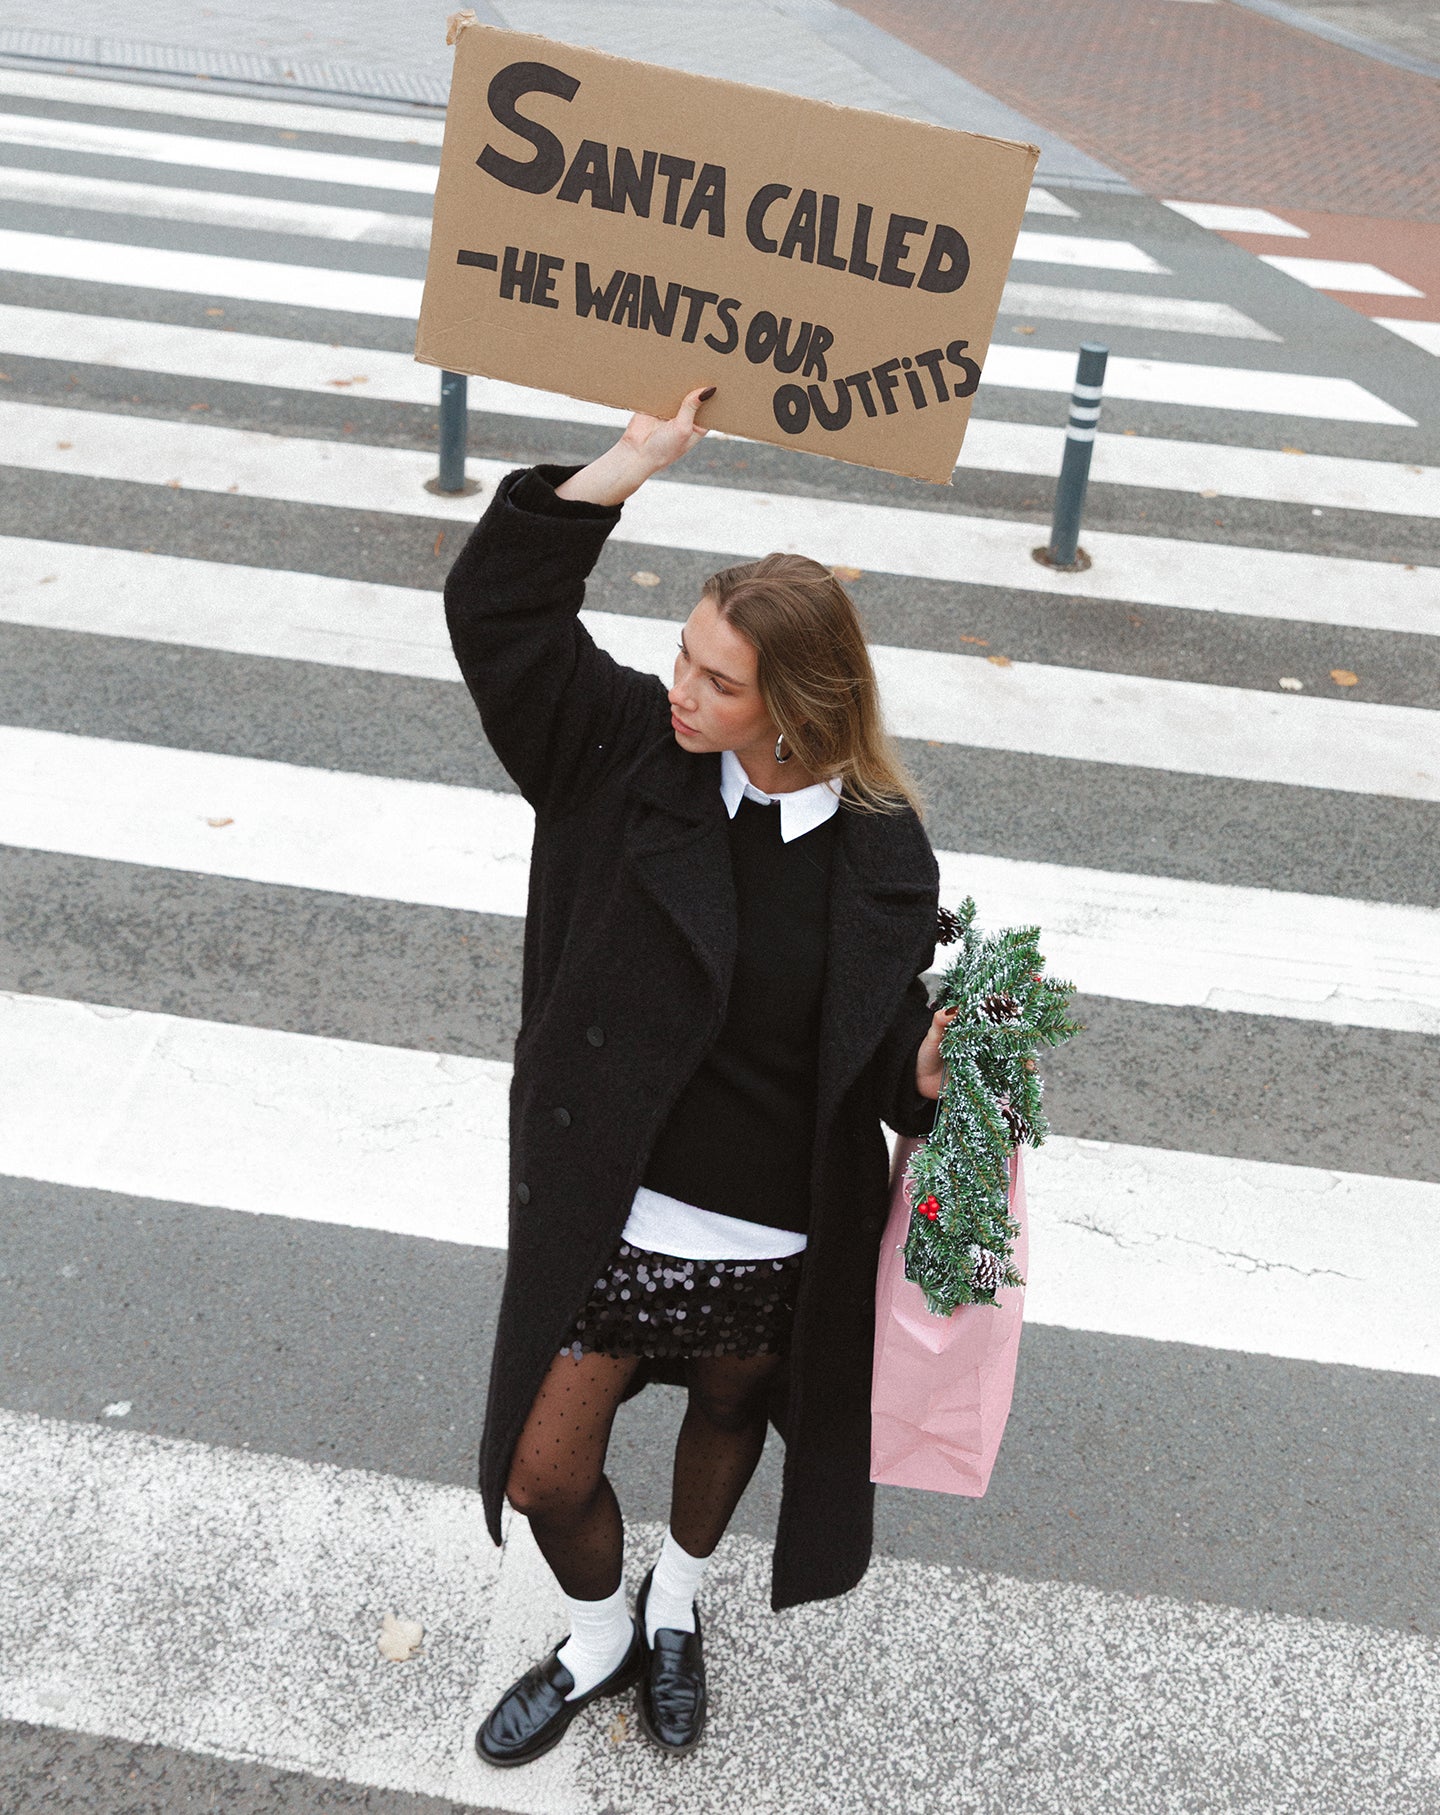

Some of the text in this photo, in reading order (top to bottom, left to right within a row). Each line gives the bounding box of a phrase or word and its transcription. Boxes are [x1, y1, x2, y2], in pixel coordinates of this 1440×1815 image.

[475, 61, 971, 294] SANTA CALLED
[575, 261, 743, 355] WANTS
[744, 310, 834, 383] OUR
